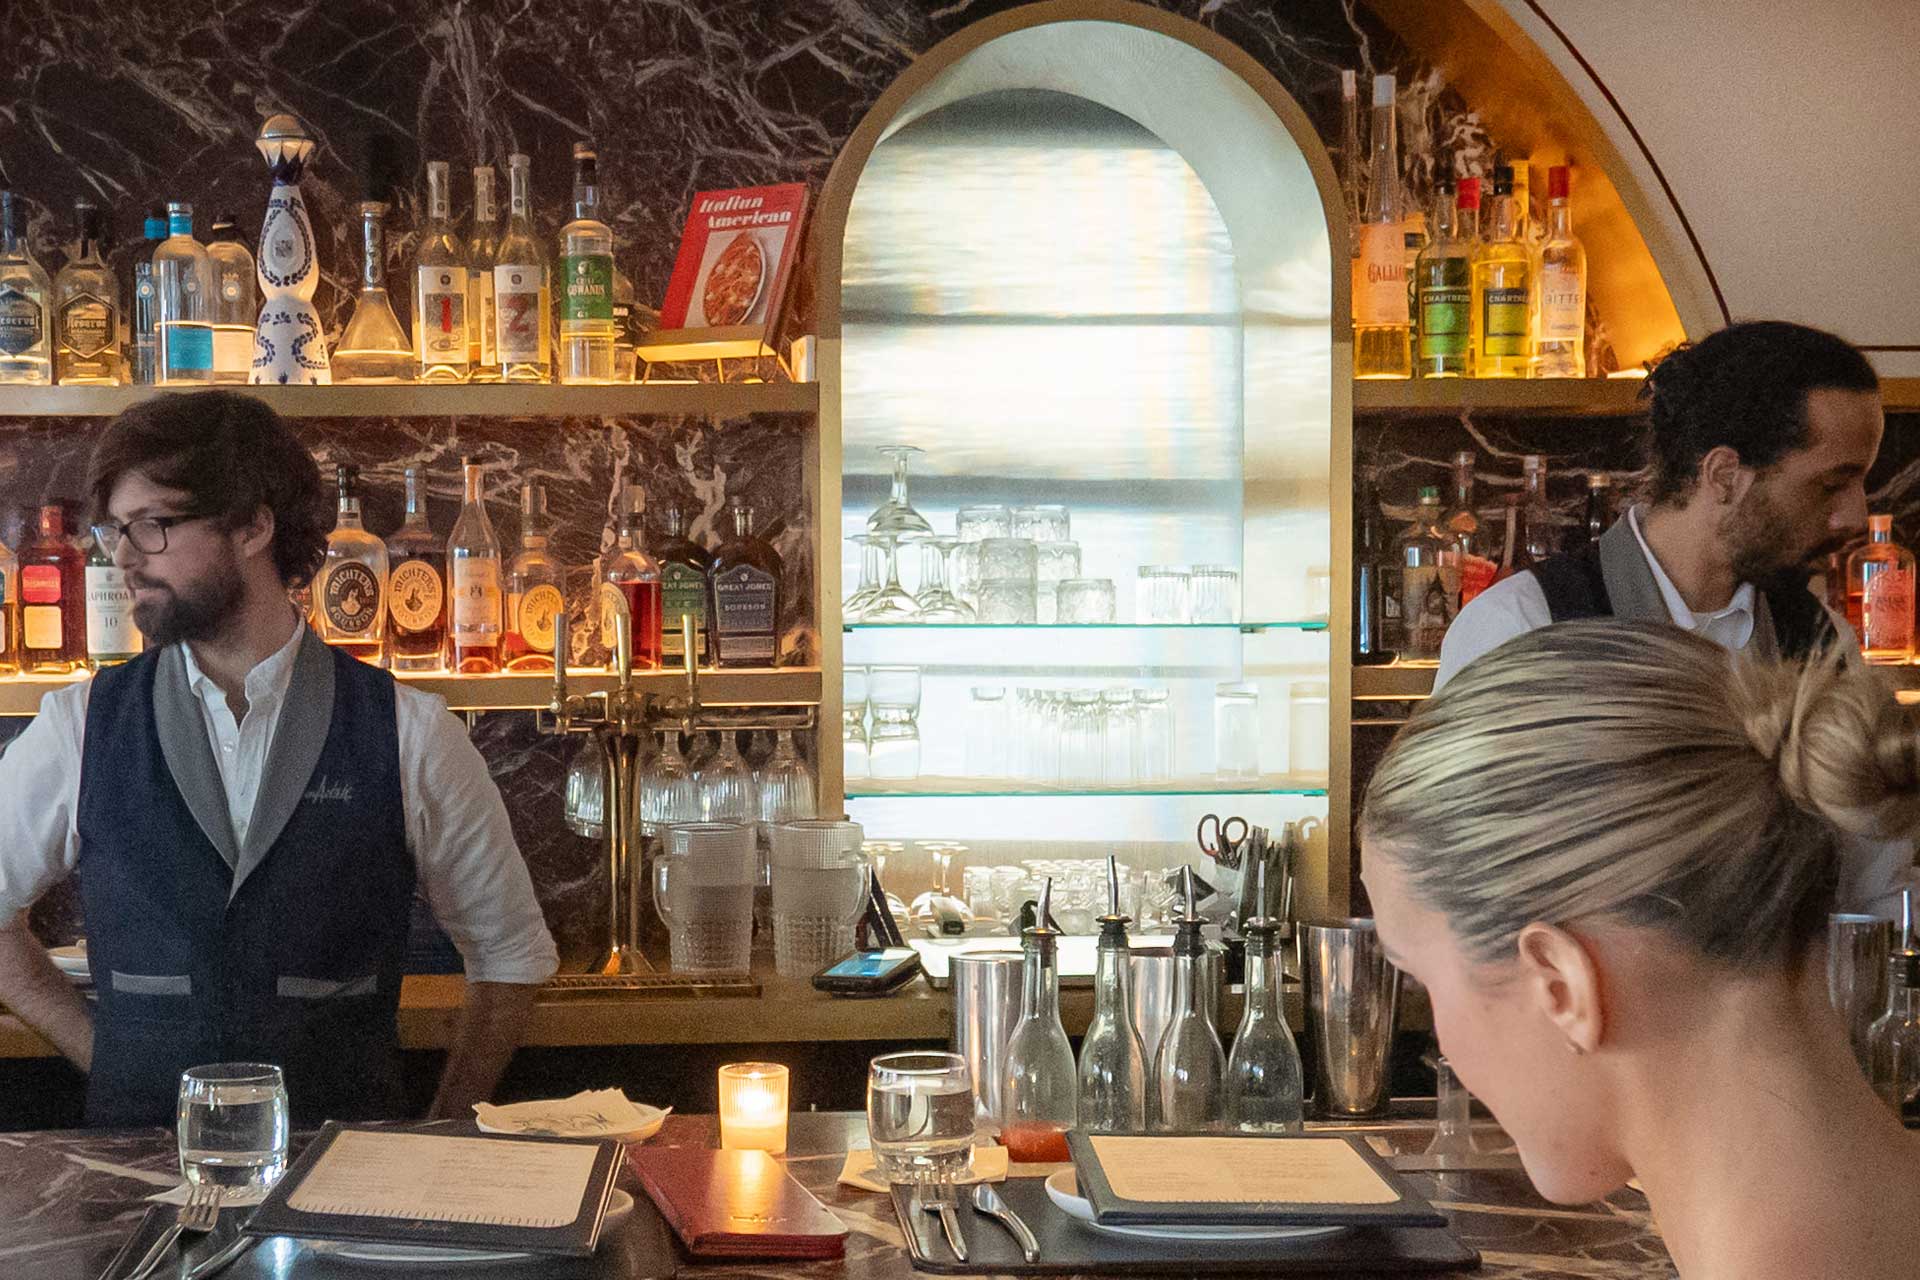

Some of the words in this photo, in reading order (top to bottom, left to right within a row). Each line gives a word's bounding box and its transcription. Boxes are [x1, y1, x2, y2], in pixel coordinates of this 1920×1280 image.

[700, 196, 764, 214] Italian
[708, 211, 792, 228] American
[1367, 263, 1405, 283] GALLI
[89, 591, 130, 601] APHROA
[104, 616, 118, 628] 10
